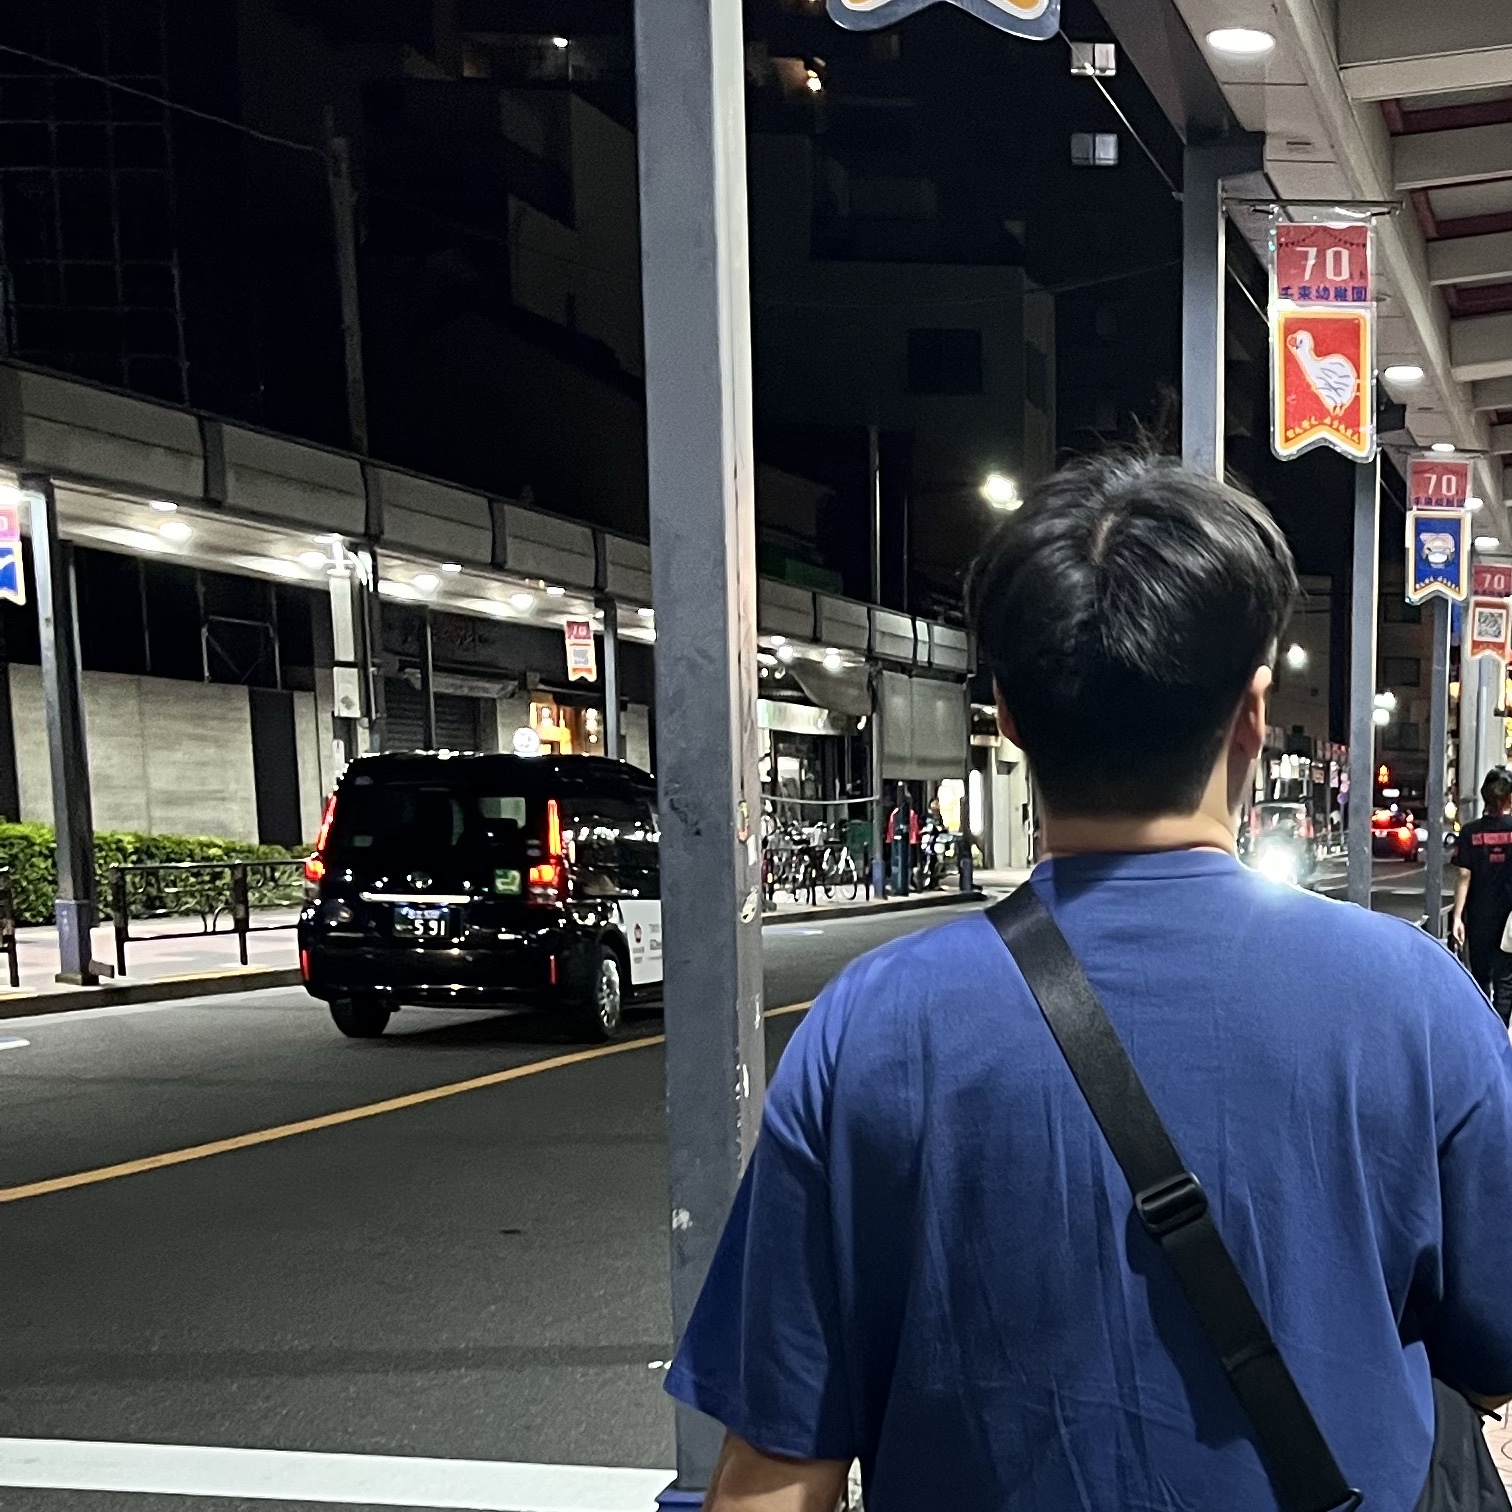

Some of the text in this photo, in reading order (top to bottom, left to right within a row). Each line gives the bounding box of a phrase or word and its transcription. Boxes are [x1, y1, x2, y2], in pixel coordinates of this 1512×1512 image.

[1295, 247, 1350, 281] 70
[1424, 473, 1457, 496] 70
[1482, 573, 1505, 589] 70
